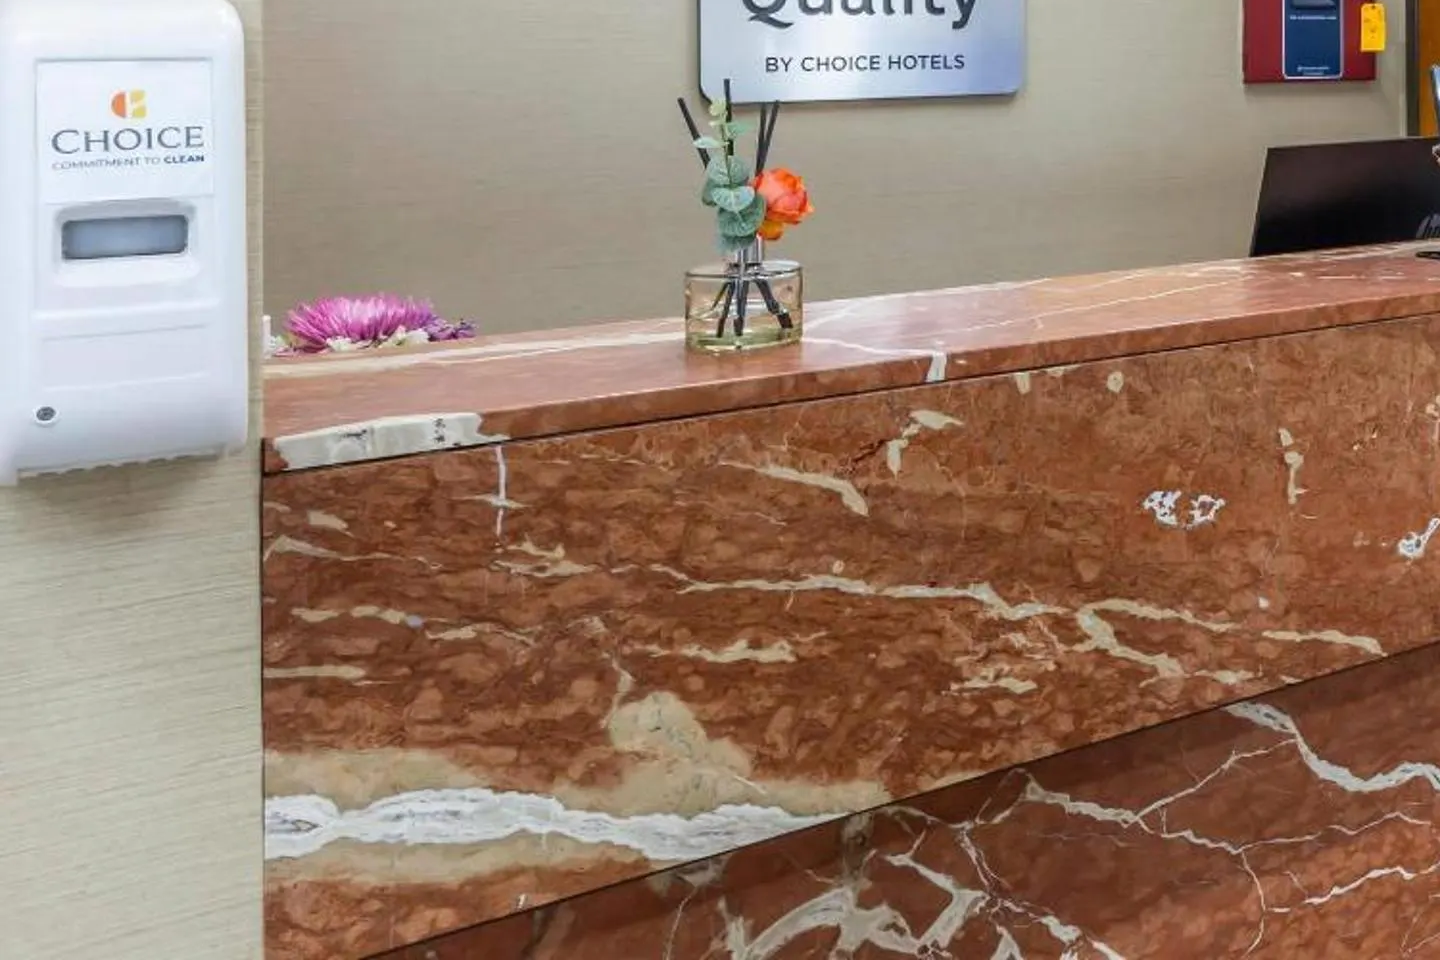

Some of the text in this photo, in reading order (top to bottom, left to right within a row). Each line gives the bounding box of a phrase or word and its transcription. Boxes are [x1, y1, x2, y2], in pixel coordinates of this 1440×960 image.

[765, 53, 965, 73] BY CHOICE HOTELS
[51, 126, 205, 155] CHOICE
[52, 154, 205, 171] COMMITMENT TO CLEAN
